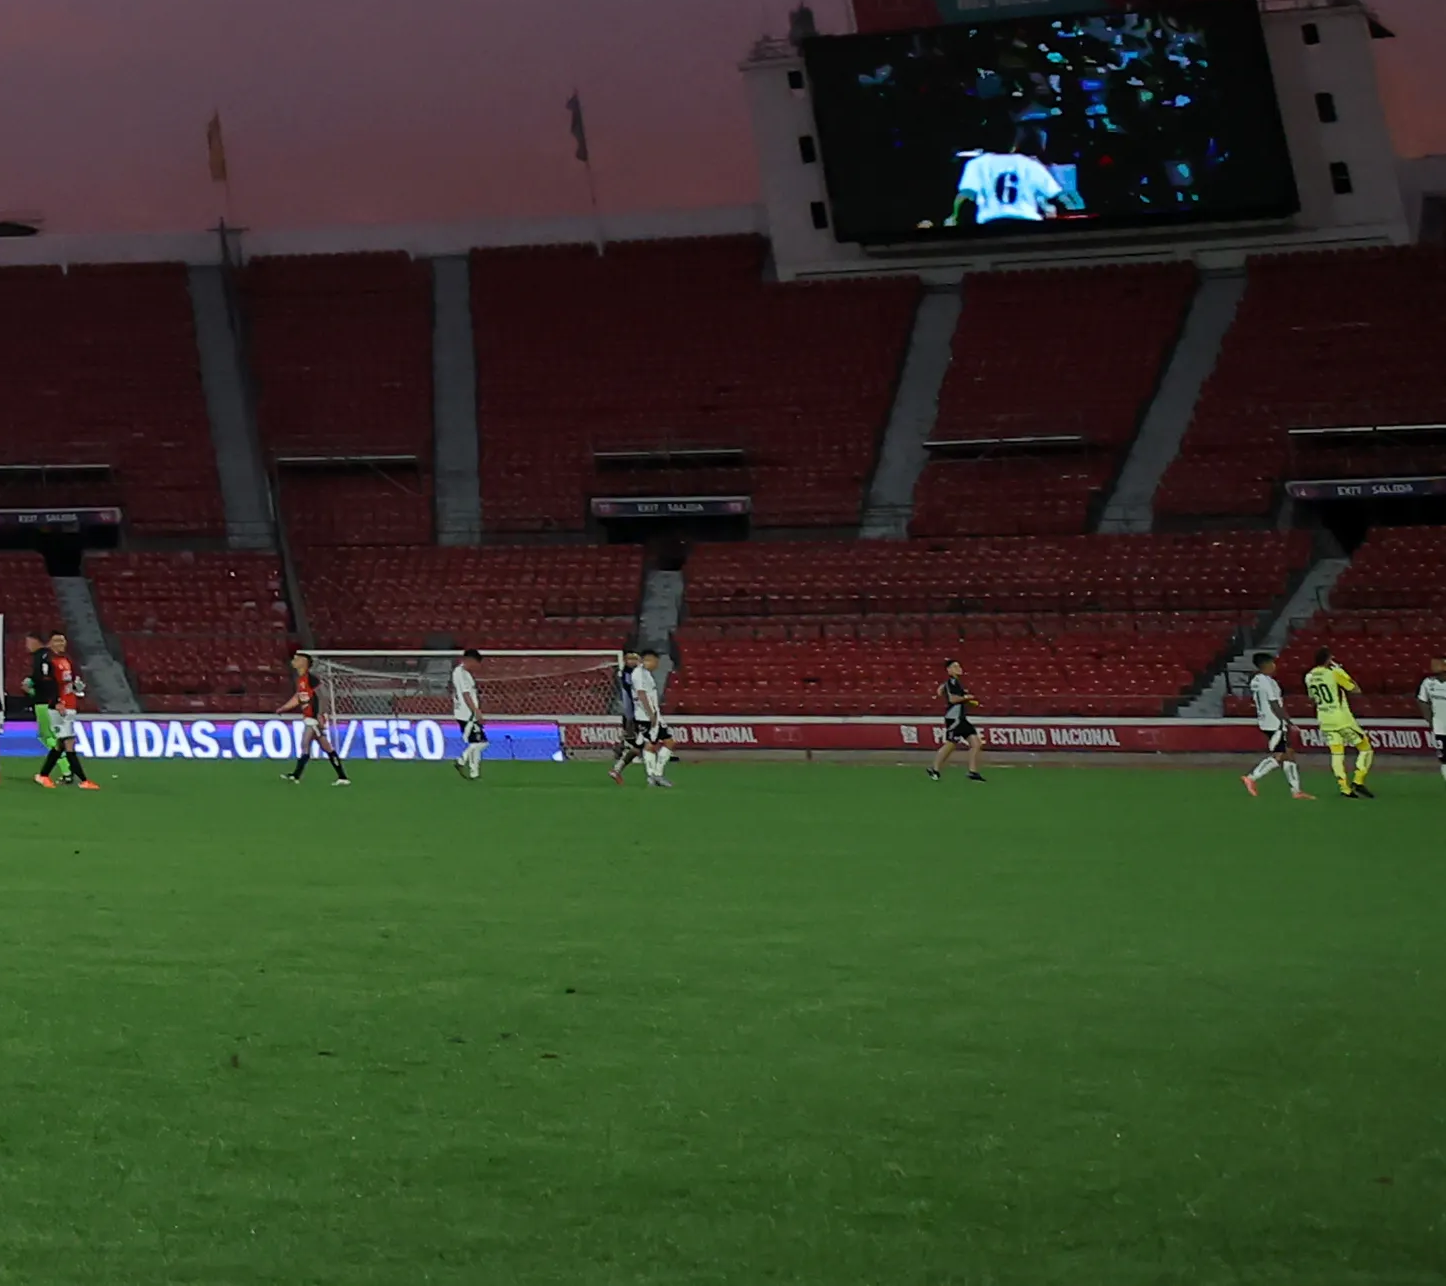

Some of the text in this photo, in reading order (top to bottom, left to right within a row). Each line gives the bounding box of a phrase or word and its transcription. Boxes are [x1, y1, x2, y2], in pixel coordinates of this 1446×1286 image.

[995, 172, 1018, 204] 6
[1337, 485, 1362, 496] EXIT
[1371, 483, 1413, 495] SALIDA
[692, 726, 759, 744] NACIONAL
[989, 727, 1048, 746] ESTADIO
[1050, 727, 1121, 747] NACIONAL
